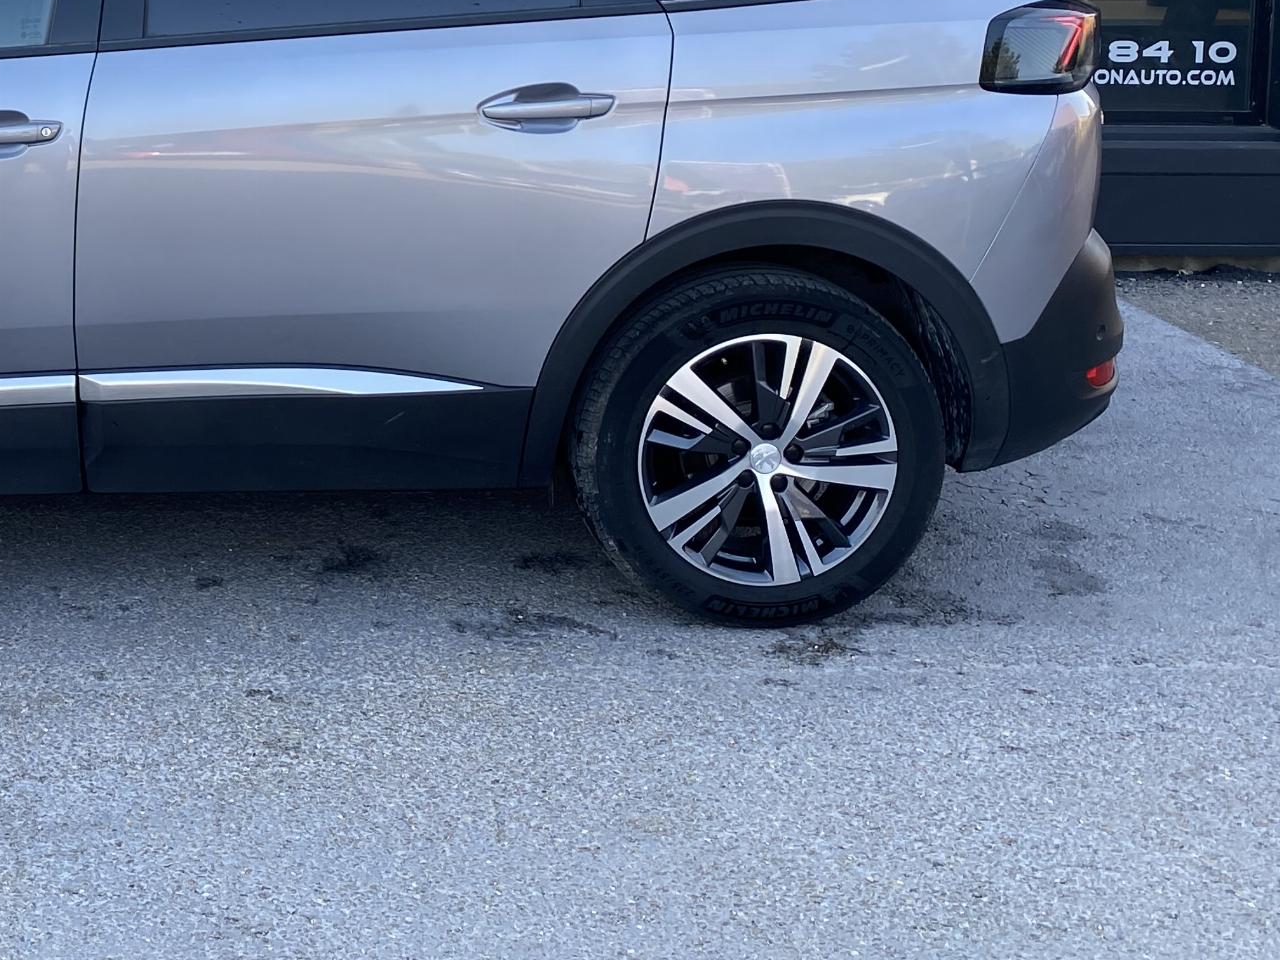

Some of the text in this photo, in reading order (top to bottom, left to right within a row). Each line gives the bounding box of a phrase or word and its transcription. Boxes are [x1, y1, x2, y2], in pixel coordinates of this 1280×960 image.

[1108, 40, 1237, 64] 84 10
[1090, 68, 1236, 86] ONAUTO.COM
[719, 302, 834, 323] MICHELIN
